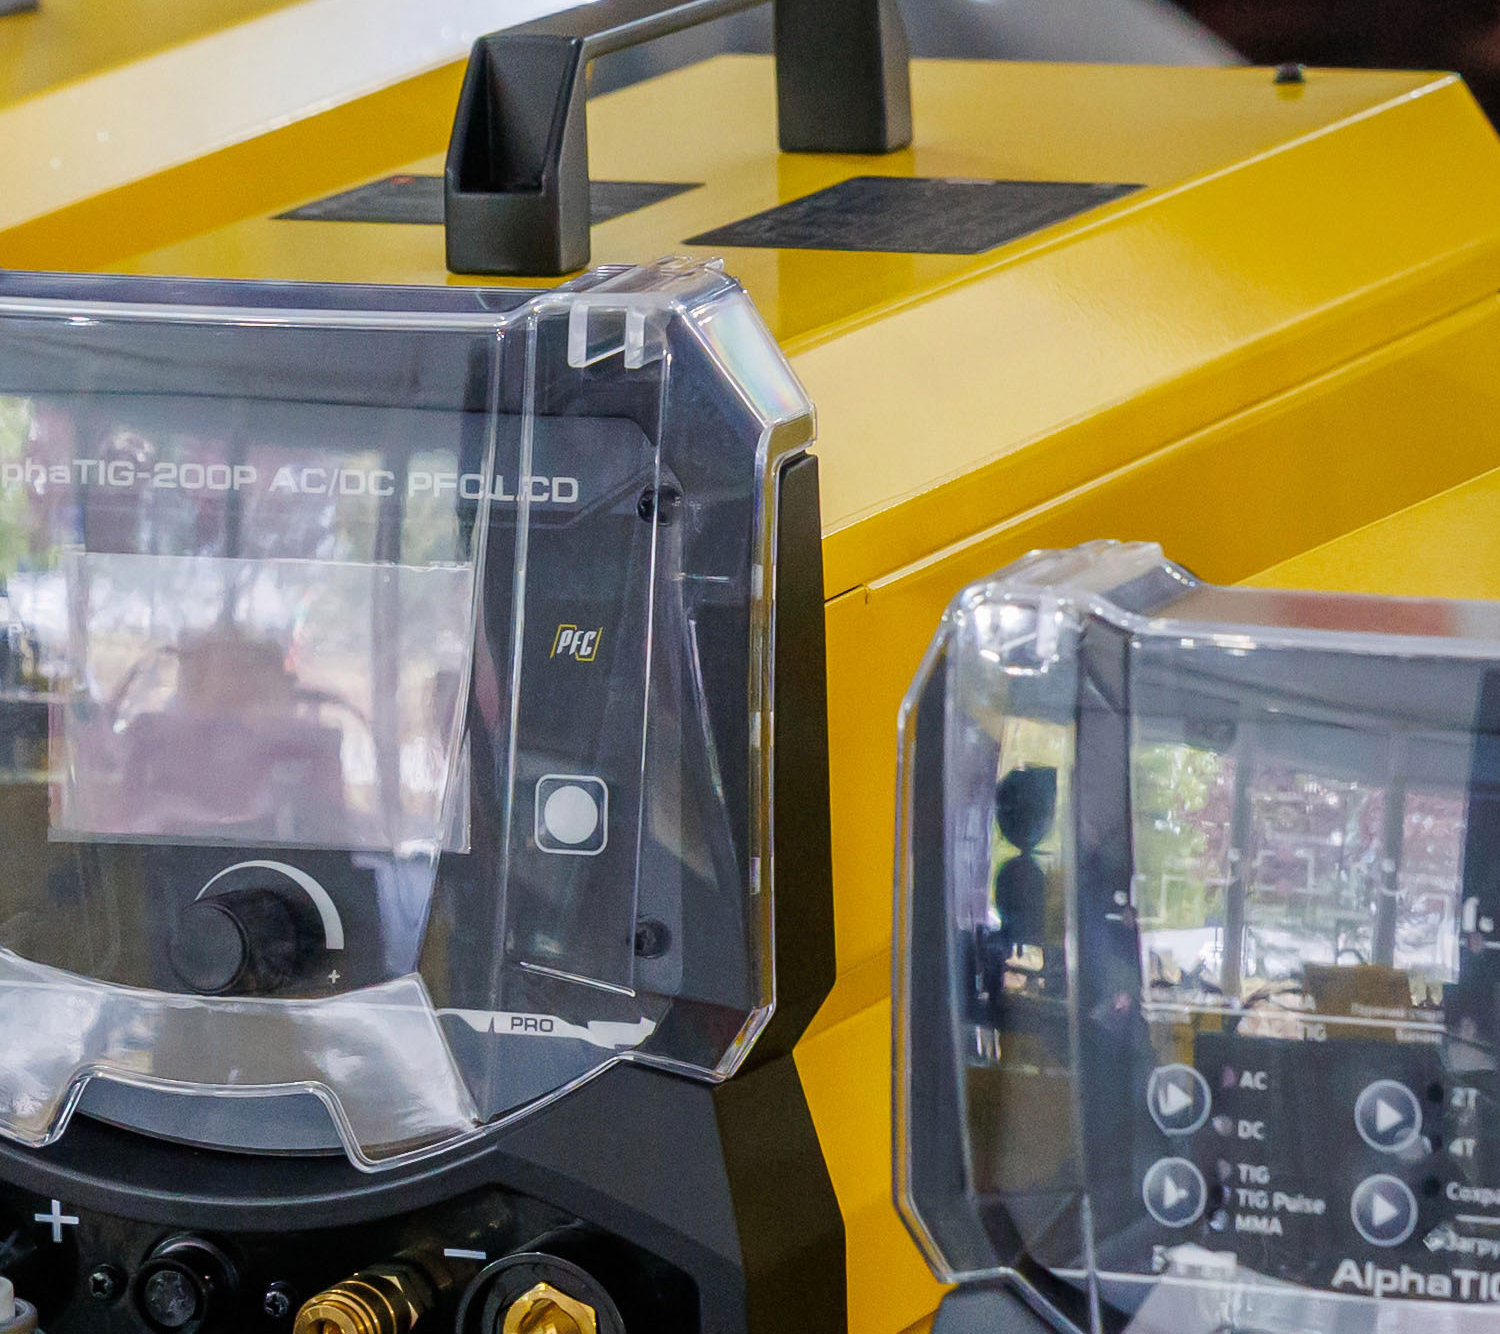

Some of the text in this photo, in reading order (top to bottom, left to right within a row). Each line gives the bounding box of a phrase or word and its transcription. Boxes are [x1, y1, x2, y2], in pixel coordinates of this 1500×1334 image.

[268, 466, 397, 497] AC/DC
[408, 474, 488, 501] PFC
[490, 475, 580, 505] LCD
[556, 629, 597, 656] PFC
[510, 1016, 554, 1033] PRO
[1238, 1069, 1268, 1091] AC
[1450, 1087, 1477, 1107] 2T
[1237, 1120, 1265, 1140] DC
[1449, 1137, 1476, 1158] 4T
[1238, 1165, 1270, 1185] TIG
[1238, 1188, 1327, 1215] TIG Pulse
[1235, 1215, 1284, 1236] MMA
